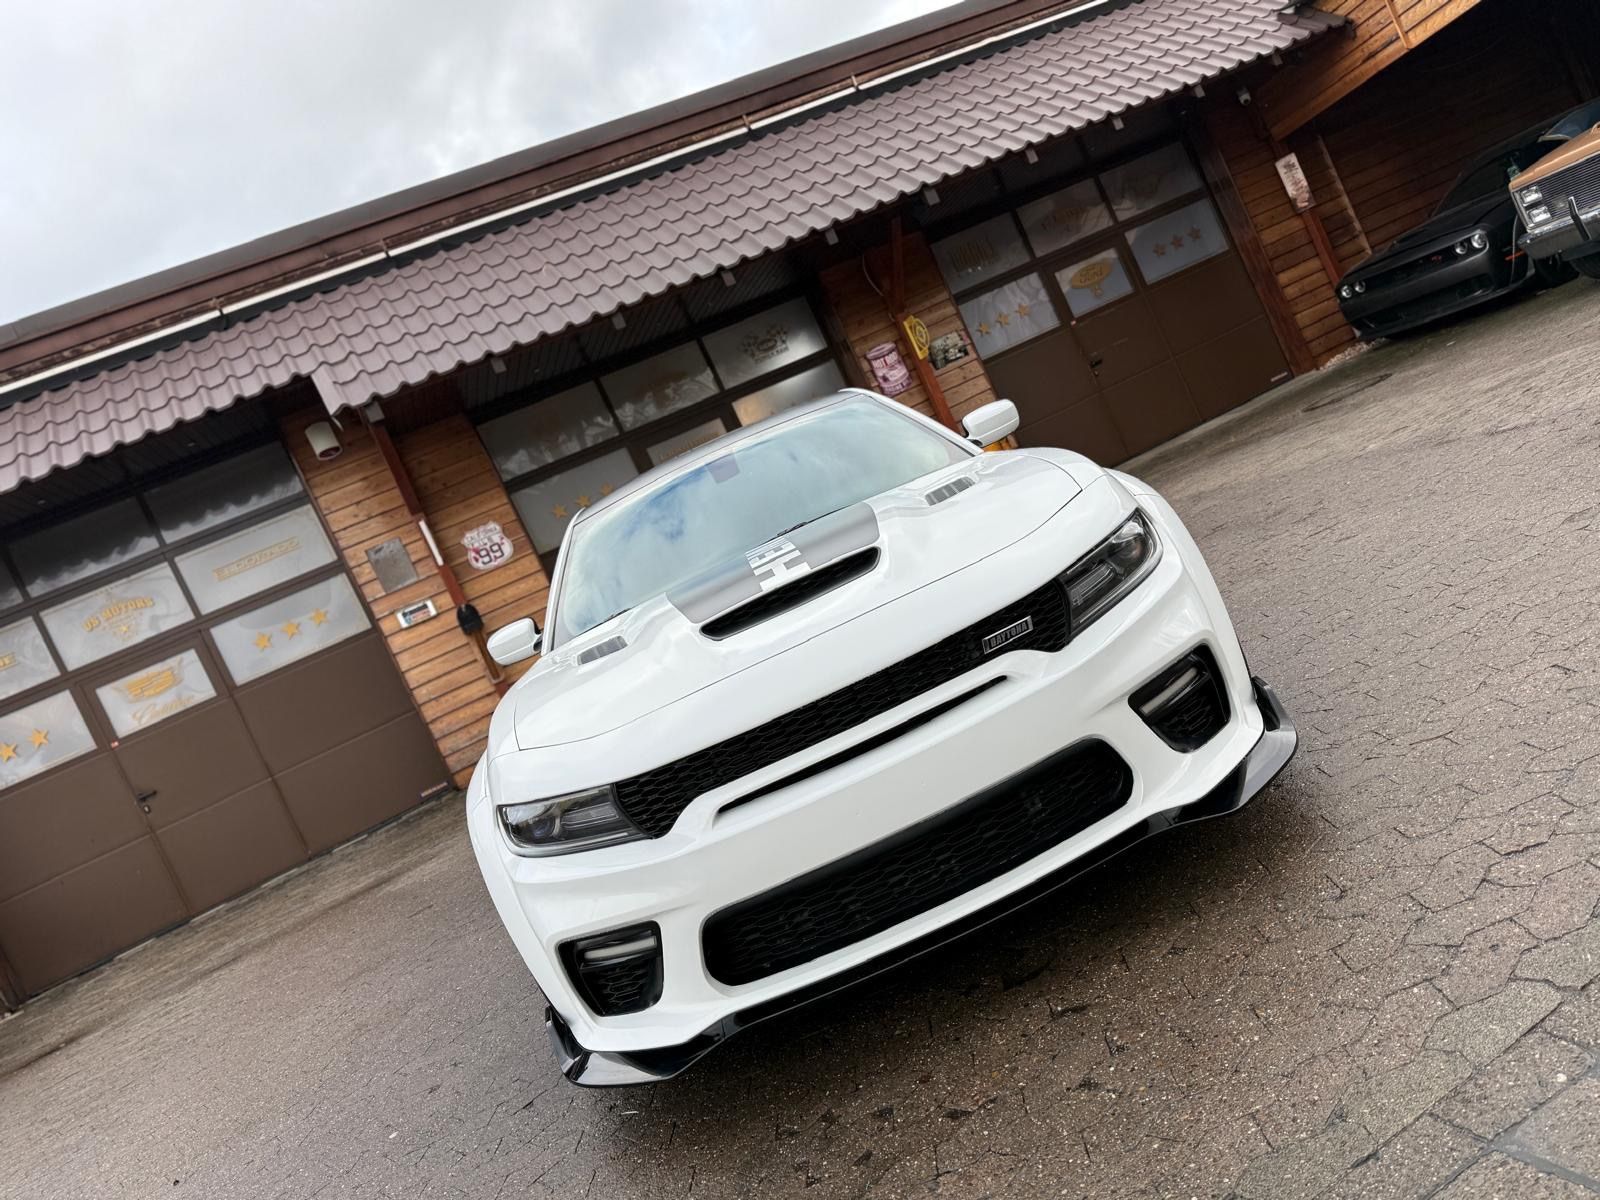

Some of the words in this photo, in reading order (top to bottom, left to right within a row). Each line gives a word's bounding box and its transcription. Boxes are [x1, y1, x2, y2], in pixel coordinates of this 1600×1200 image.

[478, 542, 505, 566] 99
[83, 614, 101, 634] US
[102, 596, 155, 623] MOTORS
[990, 621, 1028, 648] DAYTONA
